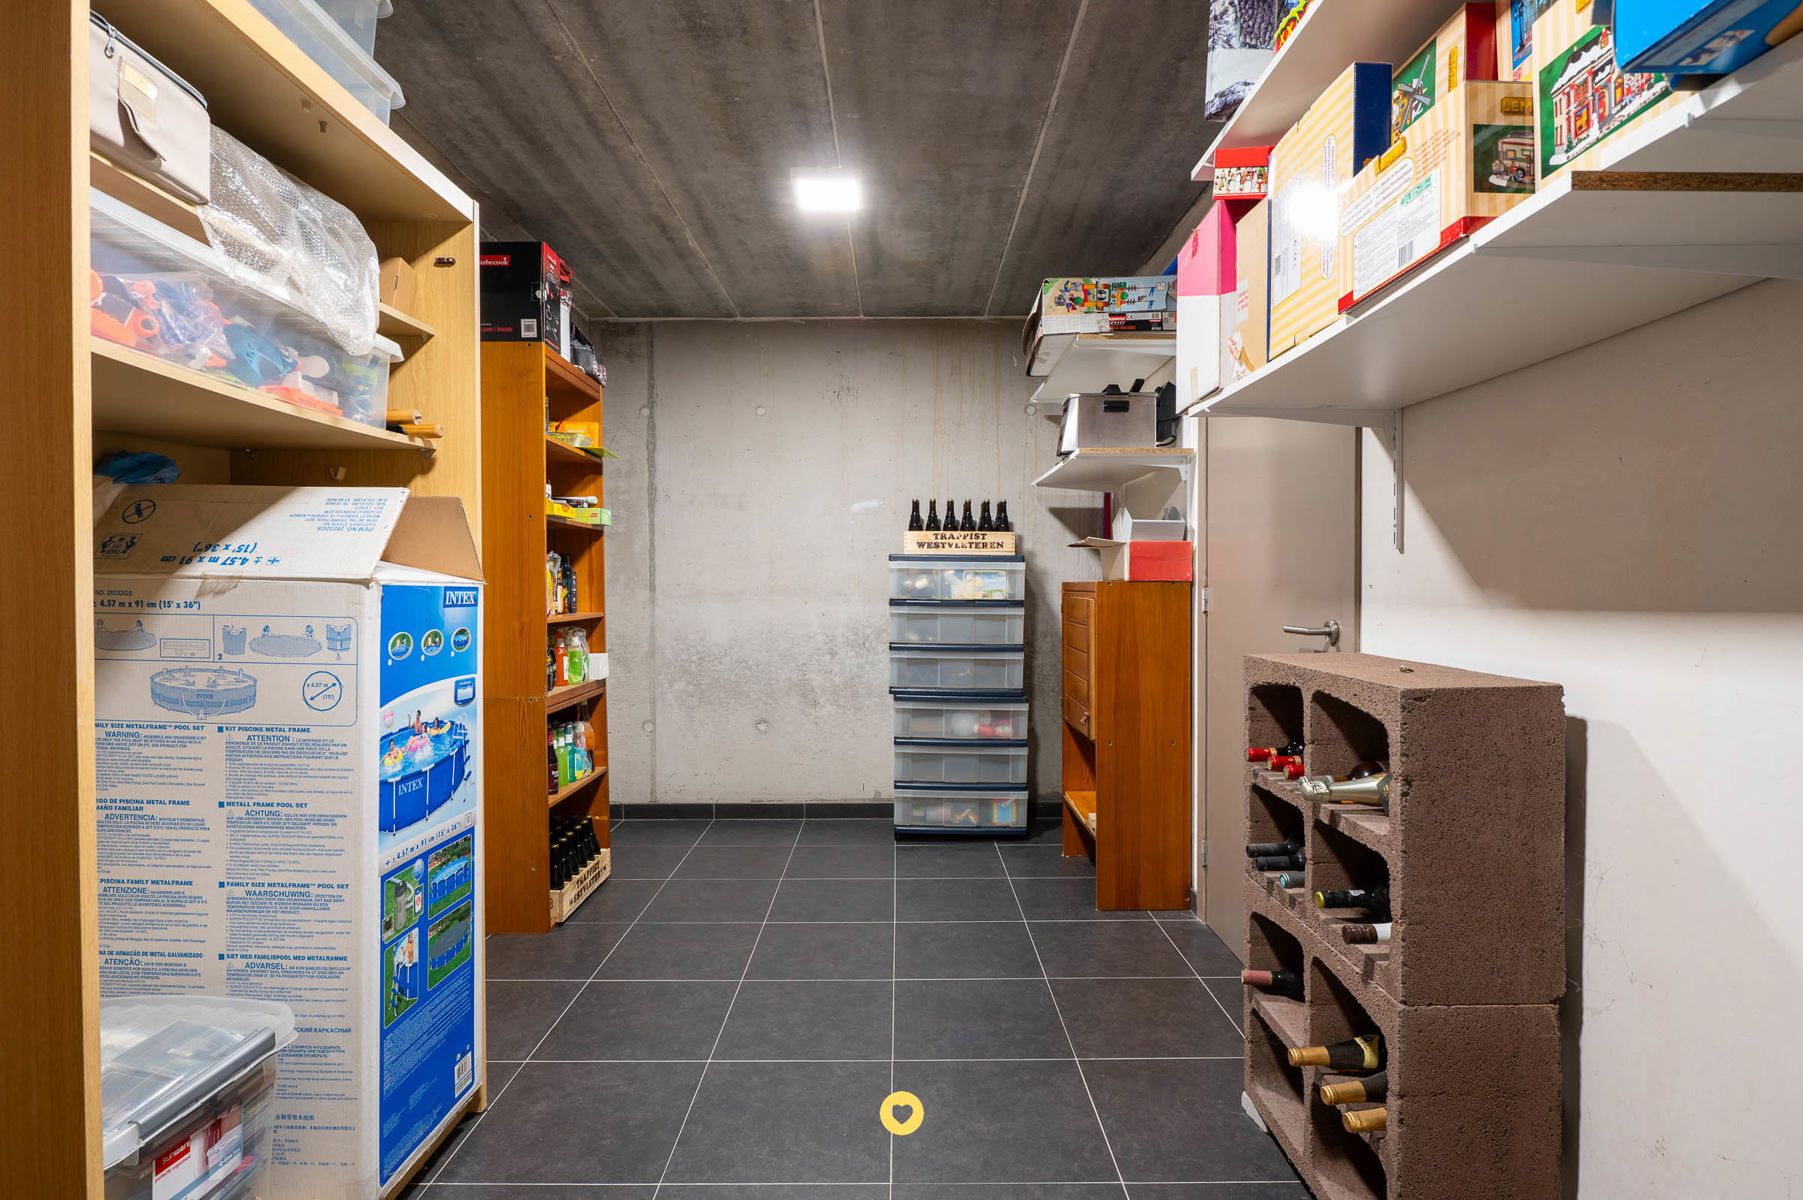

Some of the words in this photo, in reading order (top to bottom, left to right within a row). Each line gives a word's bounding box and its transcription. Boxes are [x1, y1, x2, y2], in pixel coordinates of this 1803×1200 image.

[223, 544, 232, 552] x
[179, 556, 193, 565] 91
[208, 556, 220, 565] m
[220, 555, 249, 566] 4.57
[445, 590, 475, 605] INTEX
[398, 776, 424, 796] INTEX
[245, 890, 313, 898] WAARSCHUWING:
